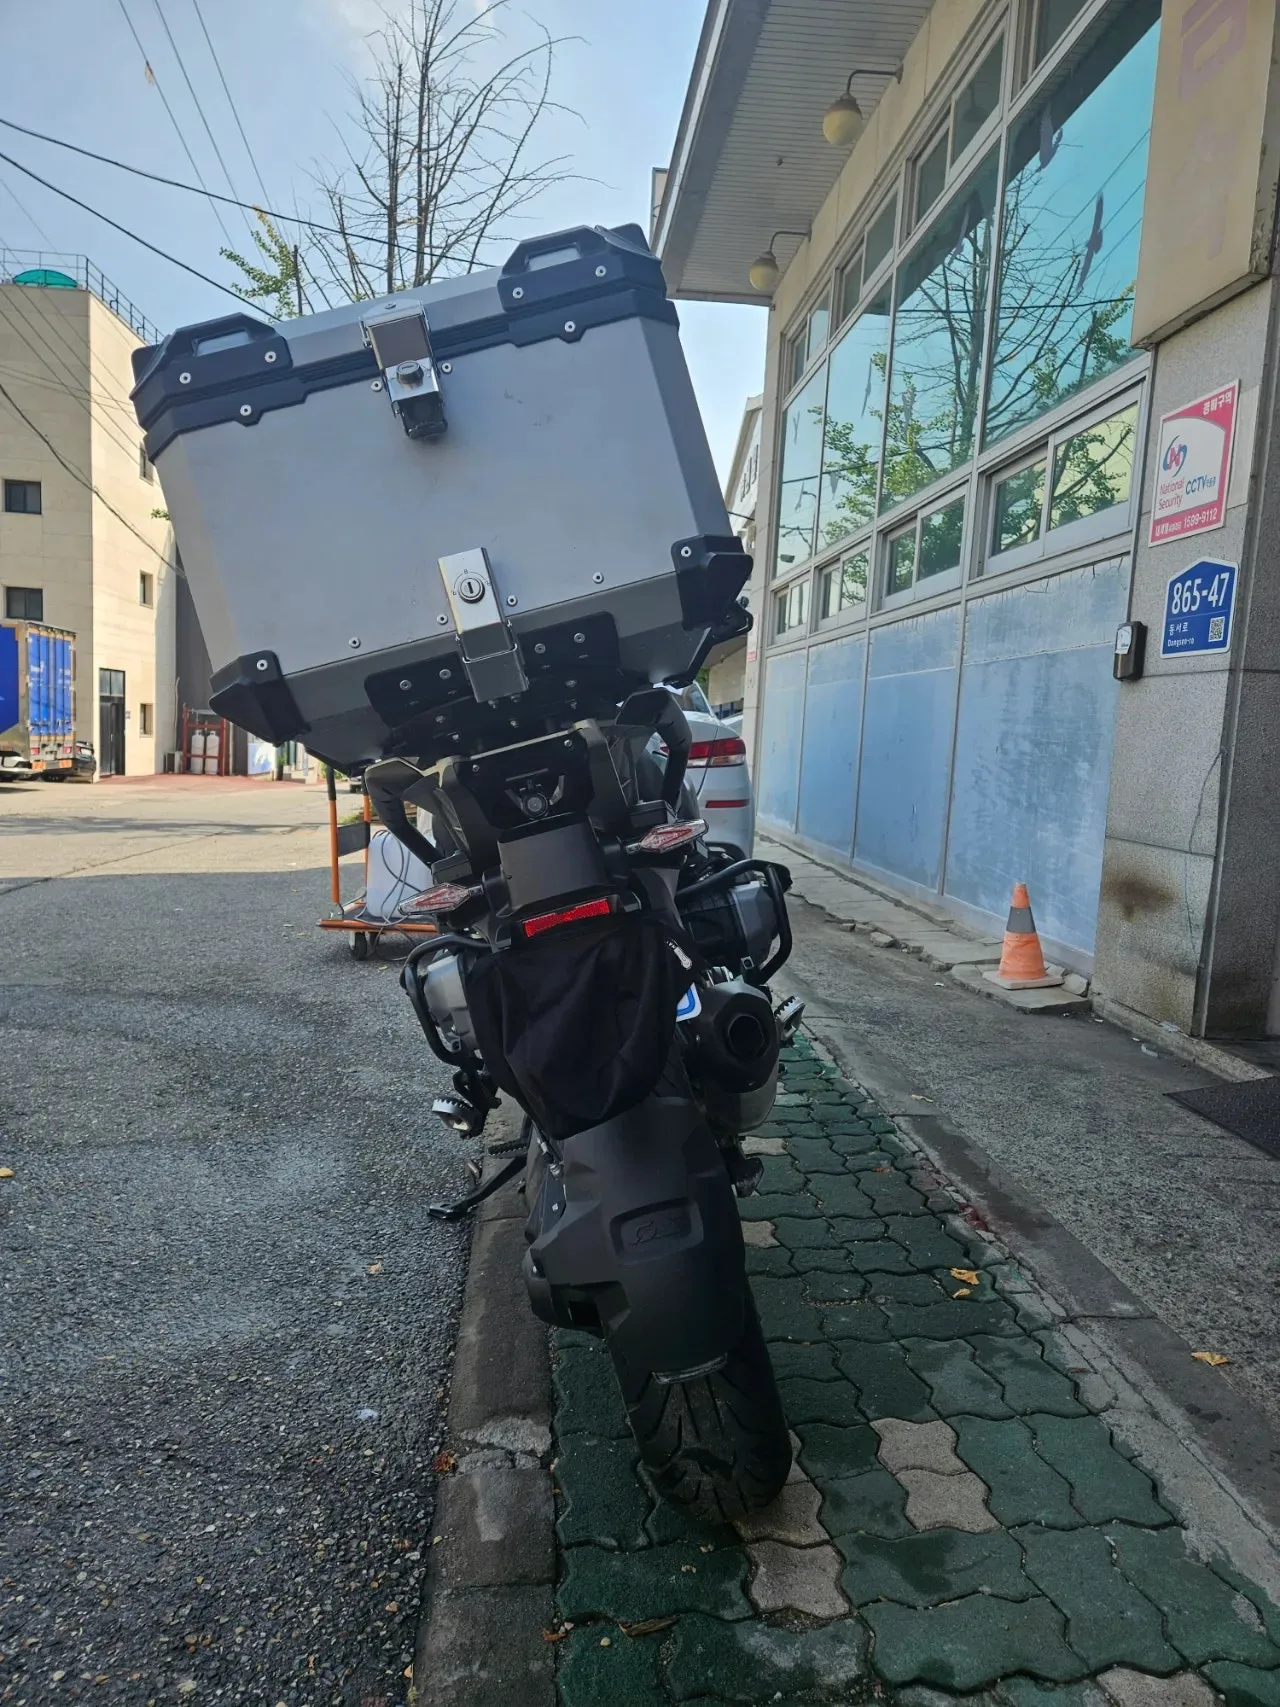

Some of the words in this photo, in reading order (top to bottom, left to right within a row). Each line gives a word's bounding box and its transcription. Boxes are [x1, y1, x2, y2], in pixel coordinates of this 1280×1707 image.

[1160, 477, 1185, 495] National
[1185, 475, 1207, 495] CCTV
[1158, 493, 1183, 511] Security
[1171, 572, 1230, 615] 865-47
[1168, 622, 1188, 636] 동서로
